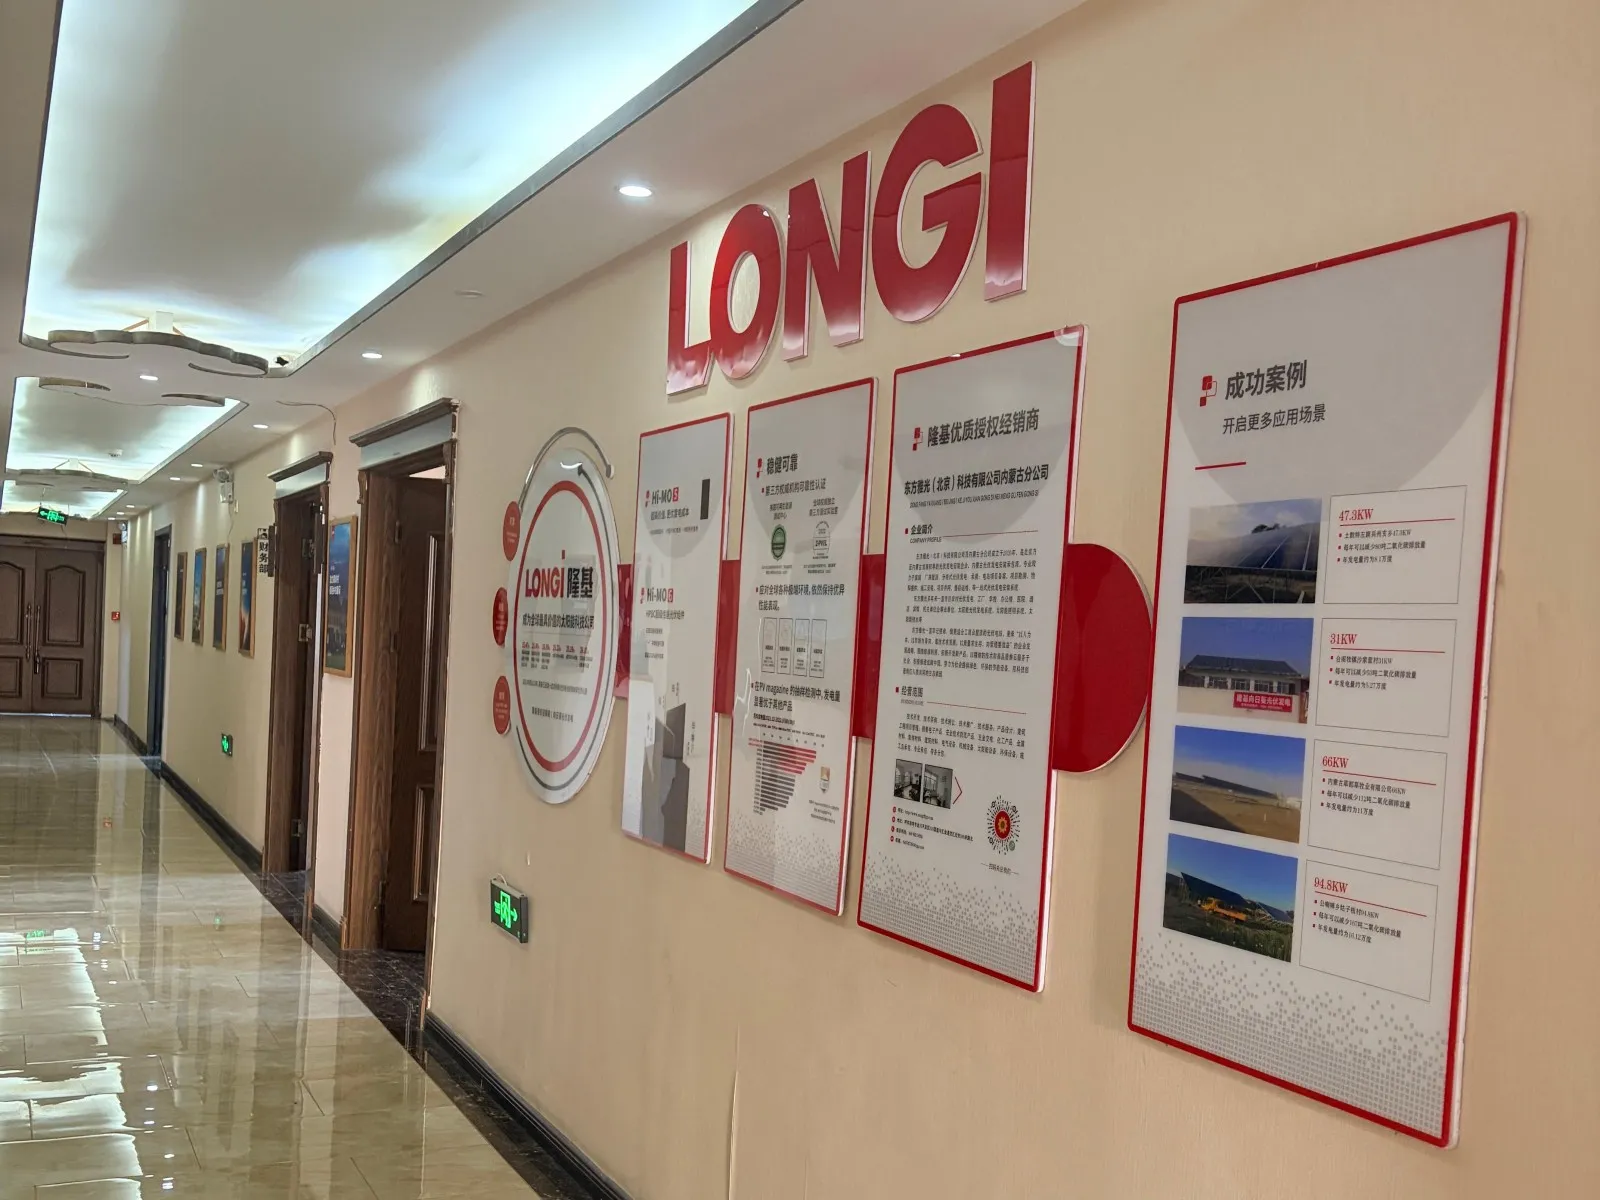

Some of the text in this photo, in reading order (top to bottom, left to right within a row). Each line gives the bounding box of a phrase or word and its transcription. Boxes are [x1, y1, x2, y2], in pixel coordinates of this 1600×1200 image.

[1224, 360, 1307, 400] 成功案例
[1222, 404, 1325, 434] 开启更多应用场景
[928, 408, 1040, 447] 隆基优质授权经销商
[767, 454, 798, 475] 稳健可靠
[765, 478, 826, 496] 第三方权威机构可靠性认证
[1338, 509, 1374, 521] 47.3KW
[911, 524, 933, 535] 企业简介
[567, 566, 593, 599] 隆基
[1330, 633, 1357, 644] 31KW
[766, 684, 789, 696] magazine
[901, 685, 924, 697] 经营范围
[753, 696, 793, 711] 显著优于其他产品
[1322, 755, 1349, 768] 66KW
[1314, 877, 1348, 893] 94.8KW
